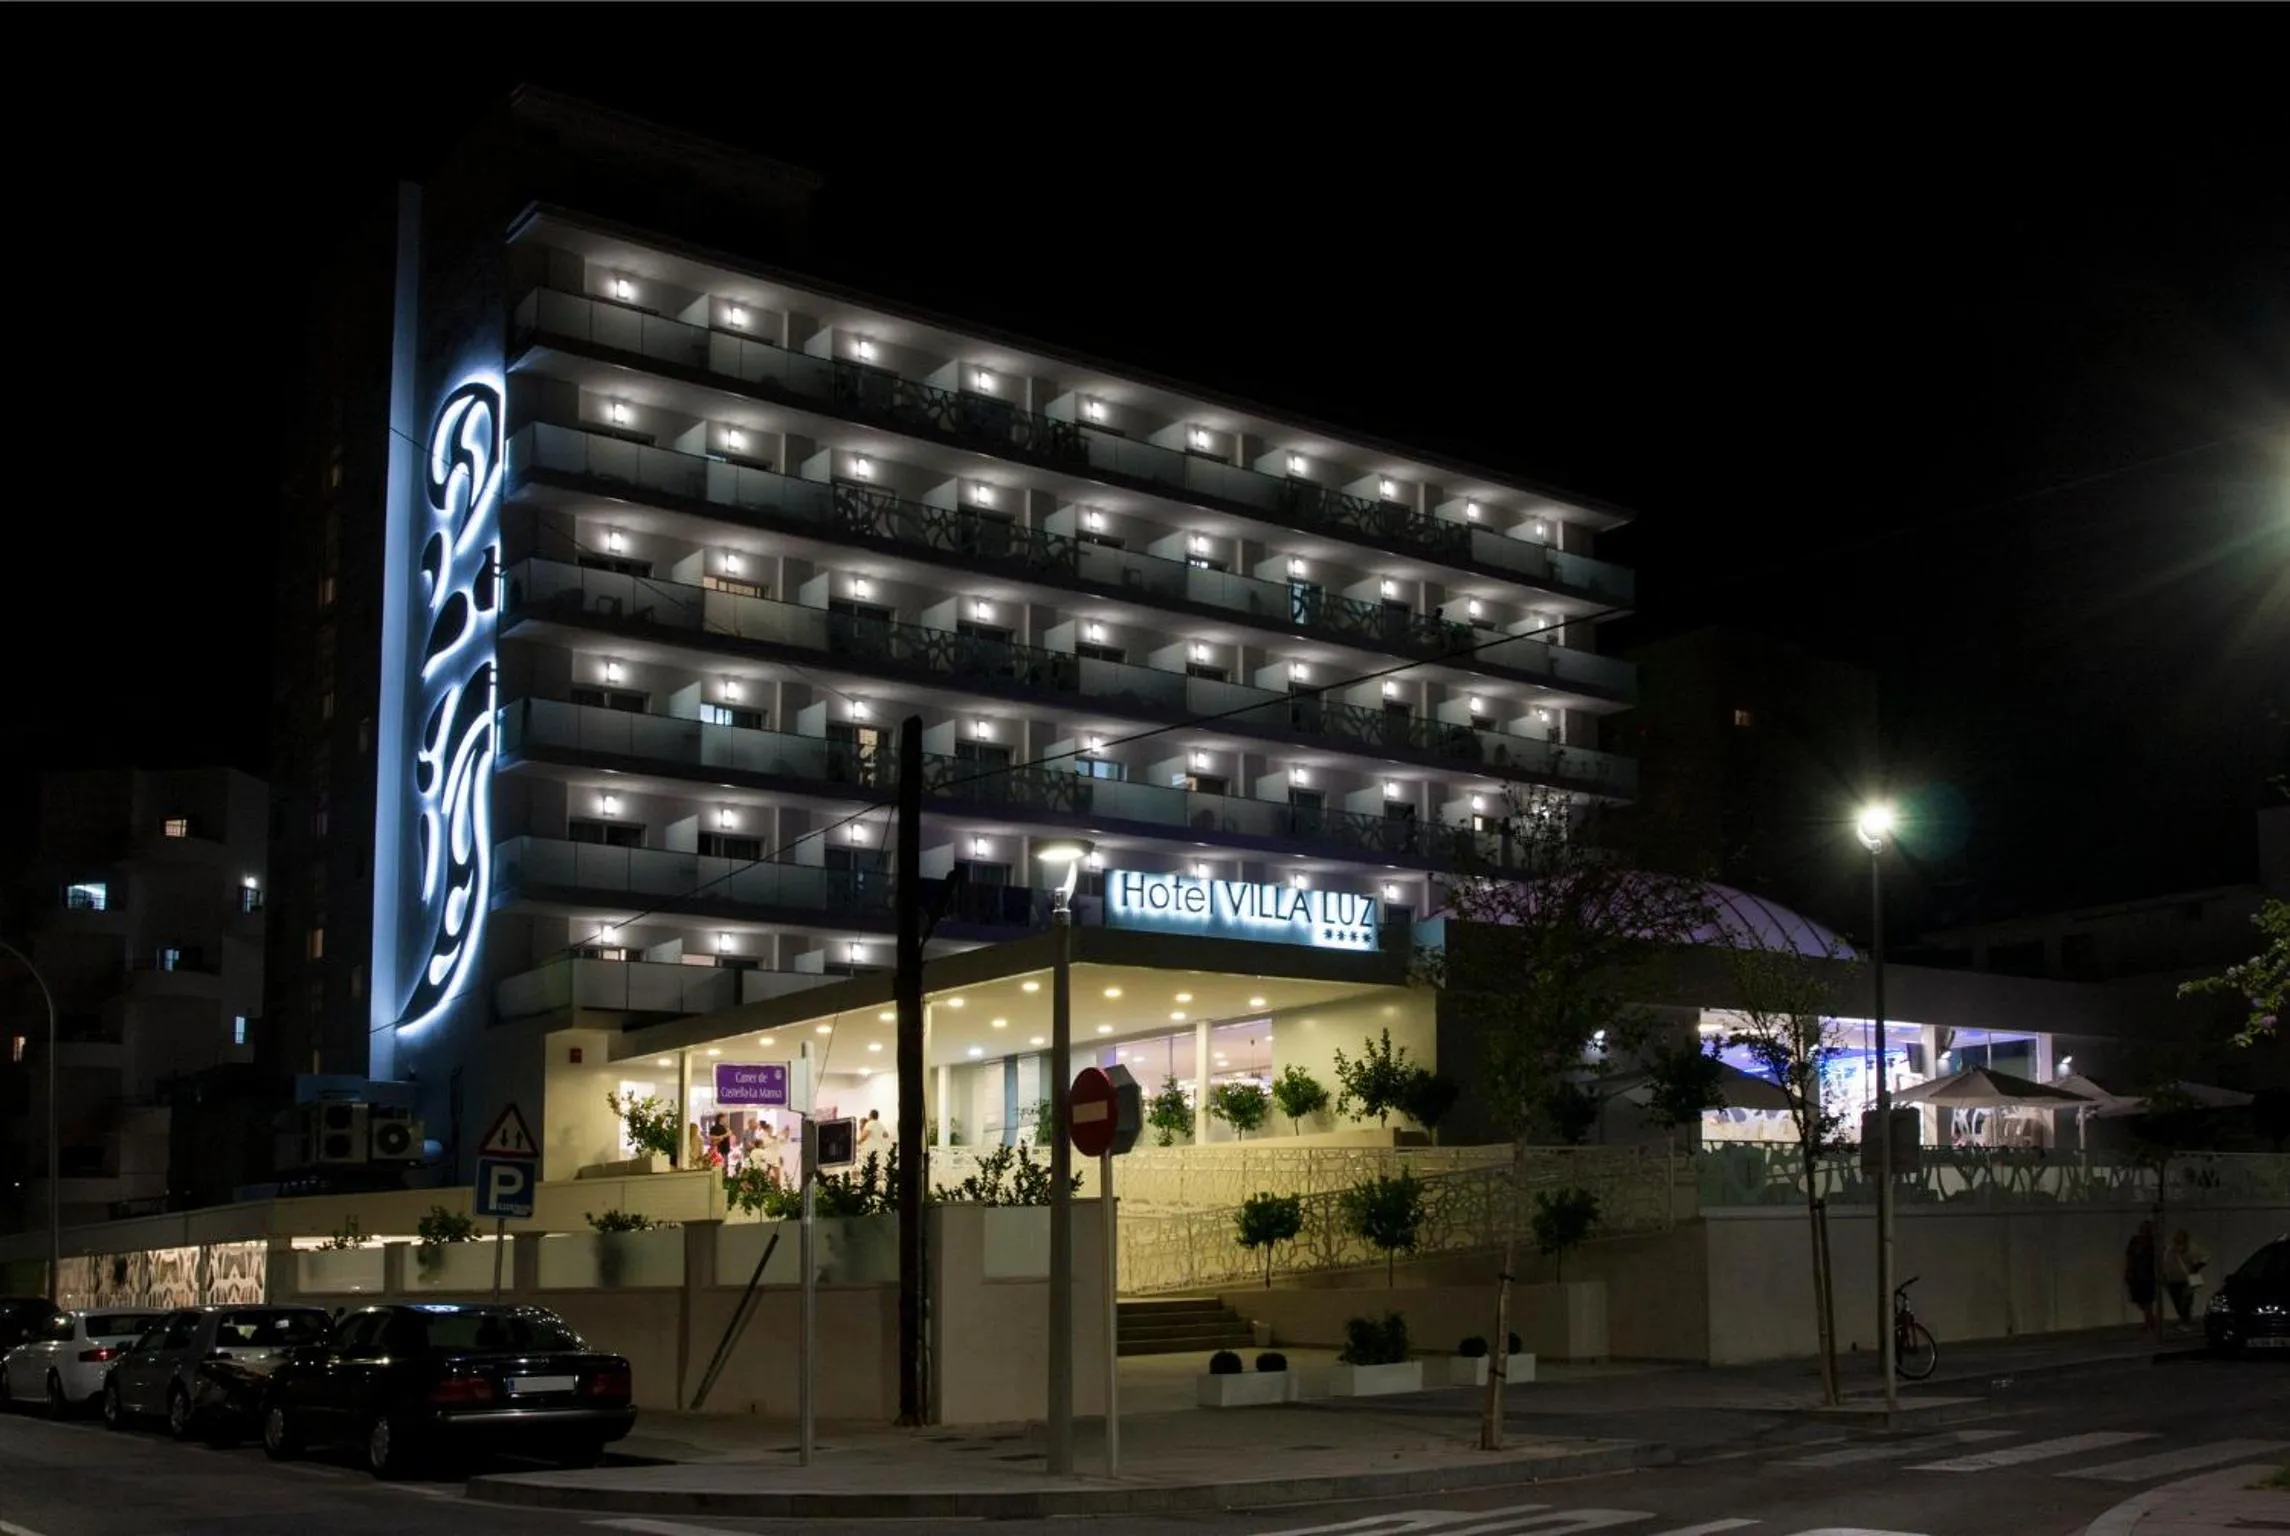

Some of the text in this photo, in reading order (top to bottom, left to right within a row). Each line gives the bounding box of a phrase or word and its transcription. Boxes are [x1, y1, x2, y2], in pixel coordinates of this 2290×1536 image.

[1121, 873, 1373, 926] Hotel VILLA LUZ
[758, 1071, 768, 1084] de
[488, 1165, 524, 1210] P
